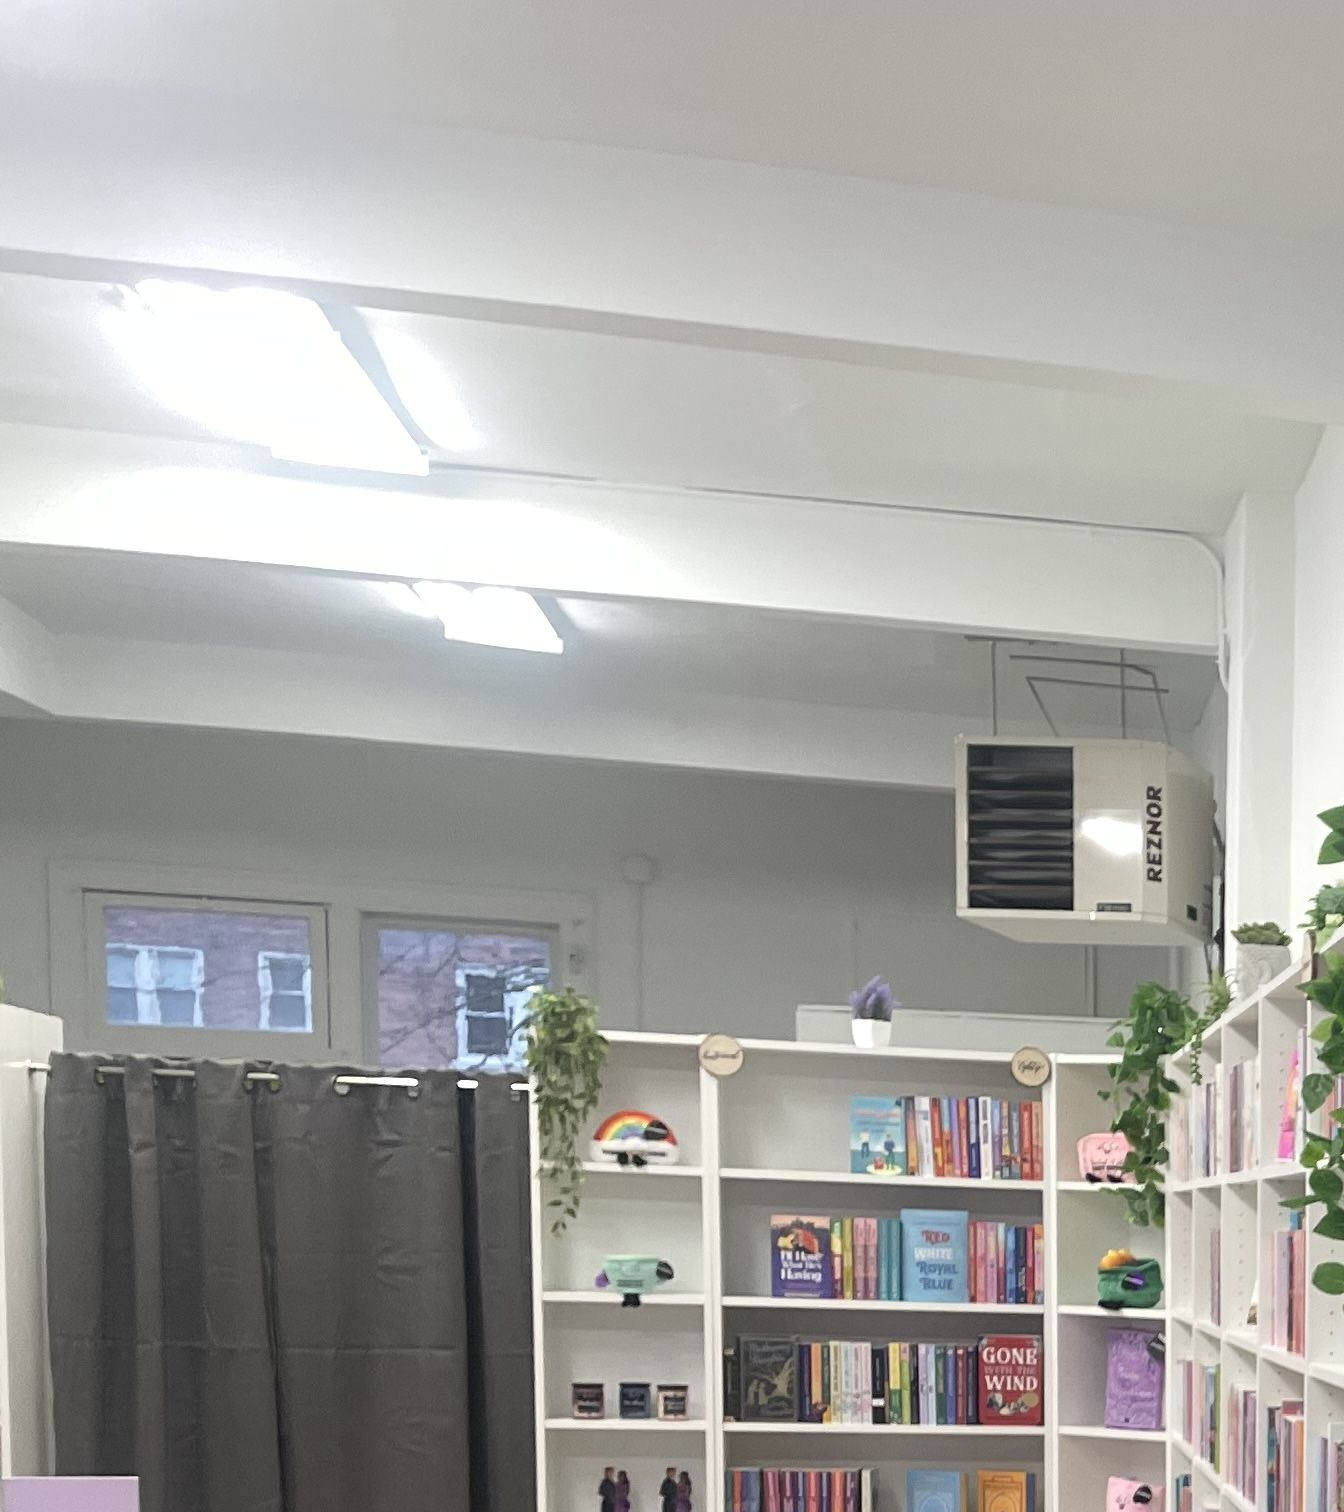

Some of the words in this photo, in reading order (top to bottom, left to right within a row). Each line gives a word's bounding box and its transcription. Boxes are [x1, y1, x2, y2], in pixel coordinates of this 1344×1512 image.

[1146, 785, 1163, 882] REZNOR
[921, 1229, 949, 1245] RED
[914, 1247, 953, 1260] WHITE
[920, 1277, 954, 1291] BLUE
[982, 1347, 1038, 1365] GONE
[985, 1375, 1038, 1391] WIND
